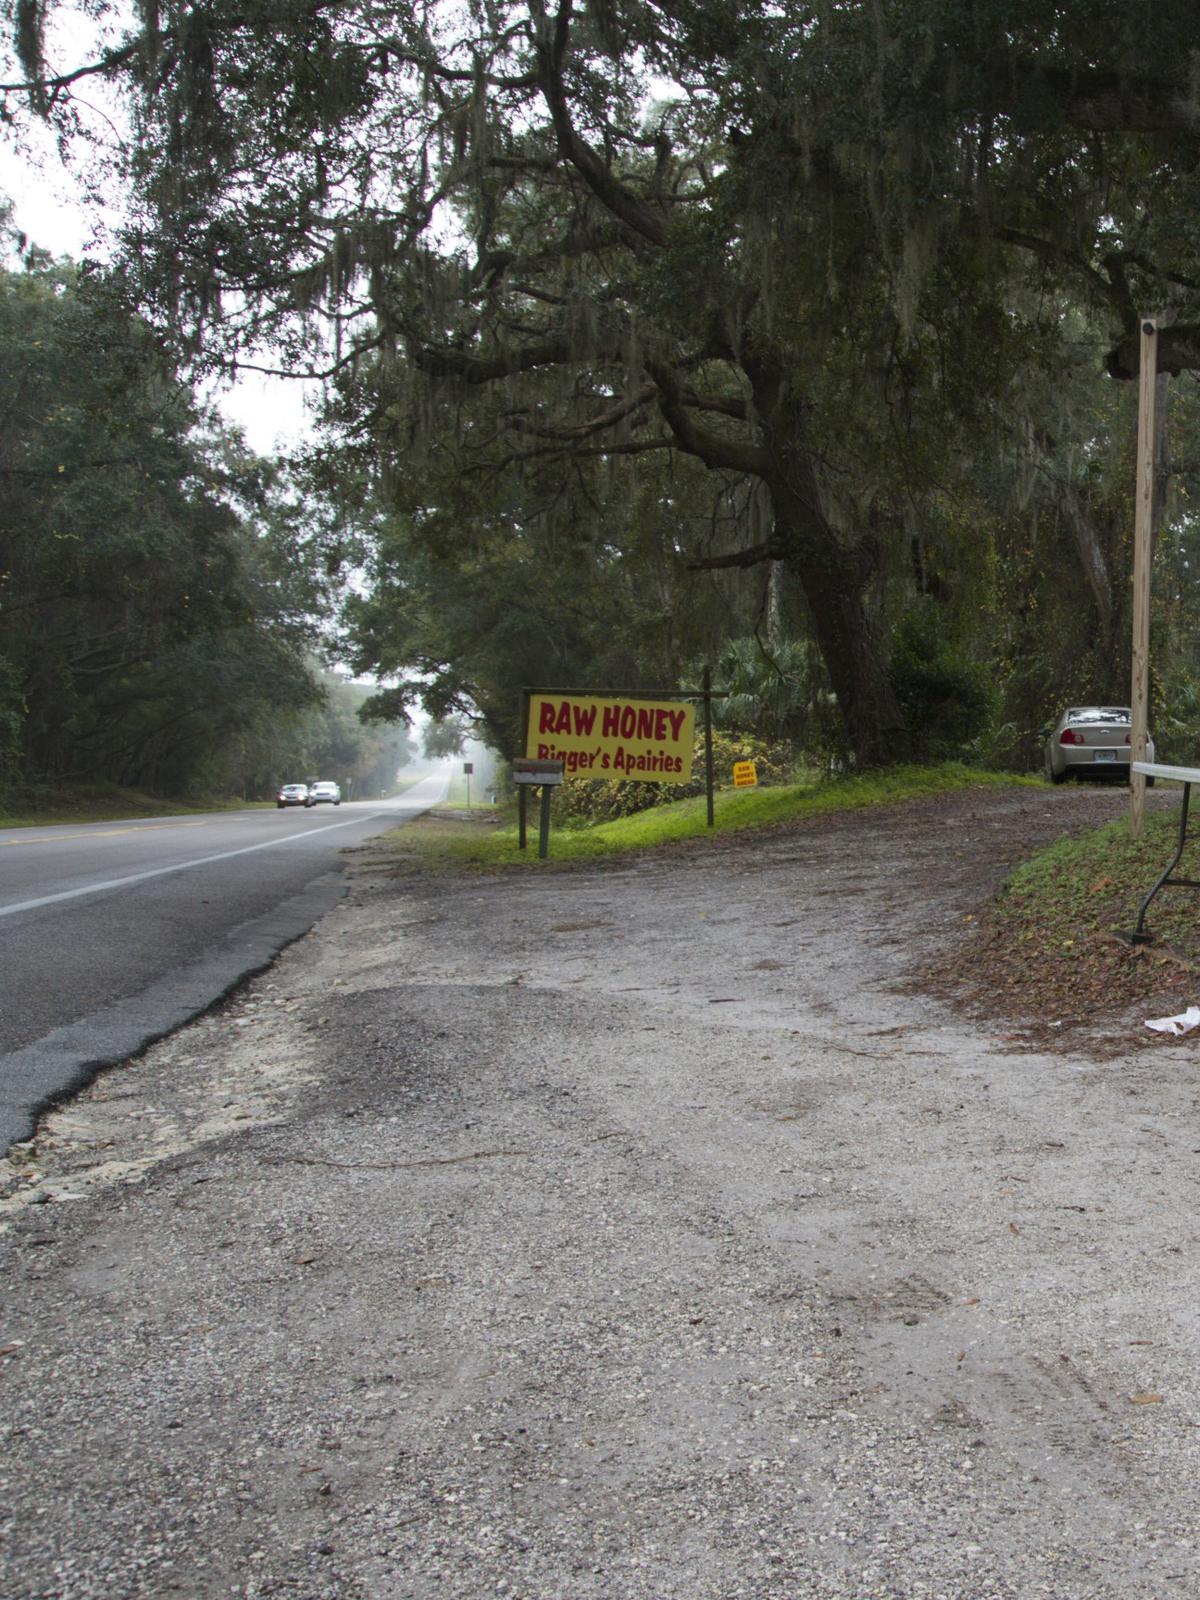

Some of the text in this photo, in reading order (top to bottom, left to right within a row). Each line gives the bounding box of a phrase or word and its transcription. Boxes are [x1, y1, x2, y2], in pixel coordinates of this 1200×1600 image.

[539, 701, 685, 741] RAW HONEY
[613, 746, 682, 775] Apairies
